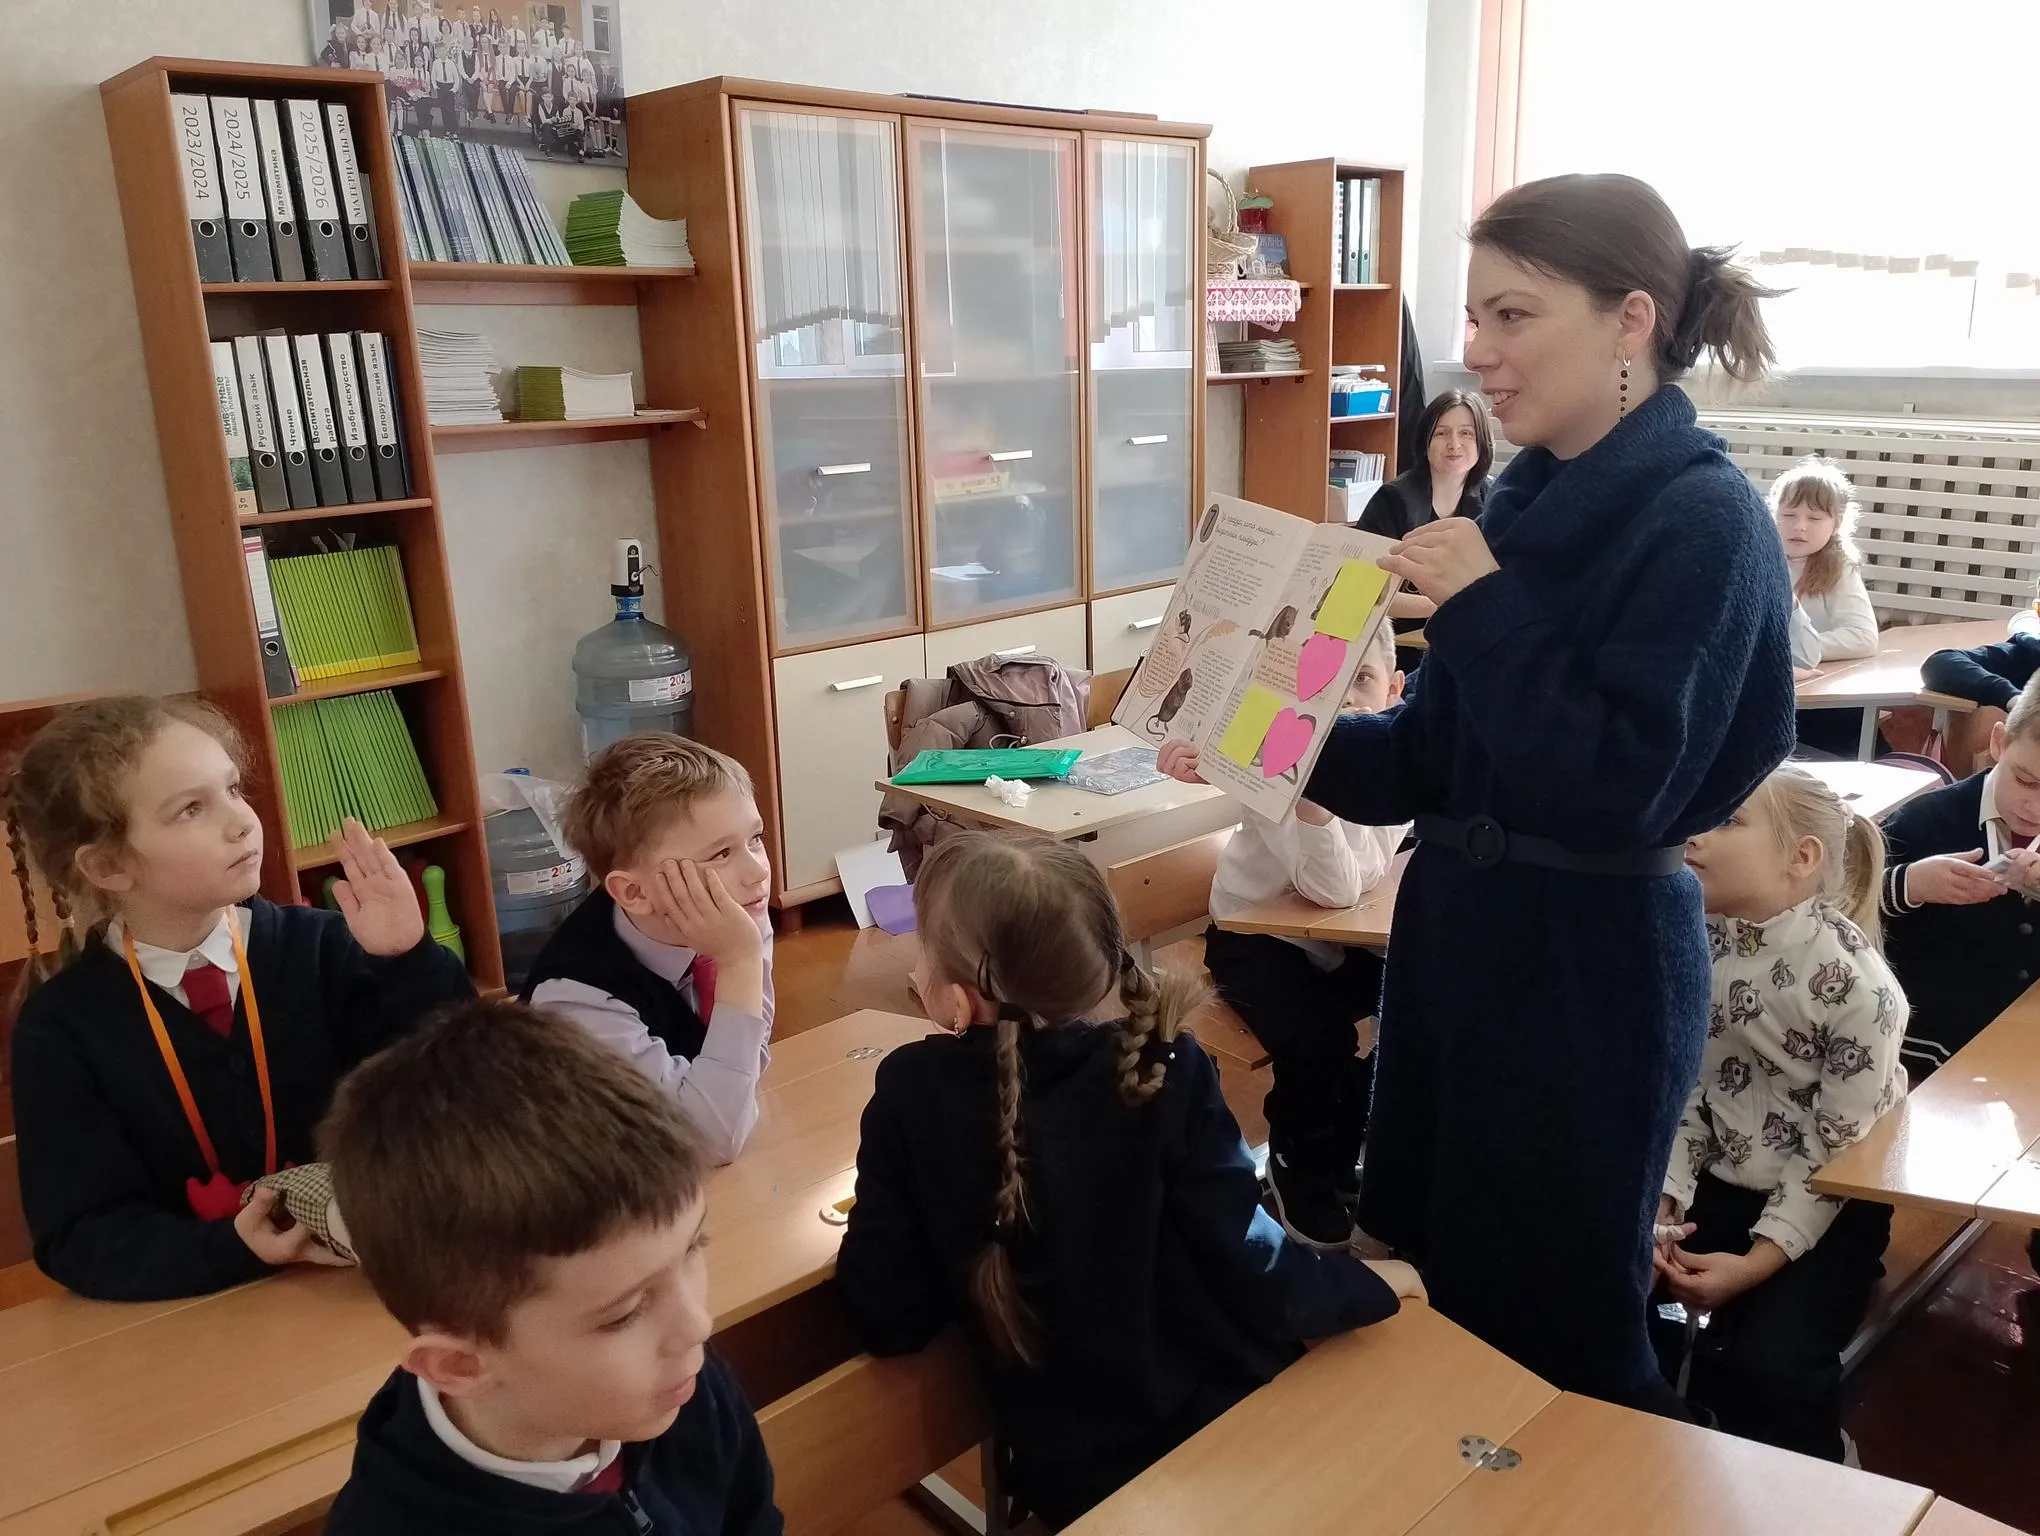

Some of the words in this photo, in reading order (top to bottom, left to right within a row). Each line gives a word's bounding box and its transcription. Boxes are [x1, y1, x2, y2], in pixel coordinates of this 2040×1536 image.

[182, 106, 210, 200] 2023/2024
[223, 108, 251, 200] 2024/2025
[336, 113, 346, 133] МО
[271, 149, 286, 216] Математика
[299, 111, 329, 209] 2025/2026
[340, 138, 361, 218] МАТЕРИАЛЫ
[250, 373, 260, 401] язык
[370, 343, 378, 370] язык
[255, 404, 267, 448] Русский
[286, 409, 296, 447] Чтение
[301, 359, 320, 444] Воспитательная
[324, 407, 337, 442] работа
[374, 372, 389, 440] Белорусский
